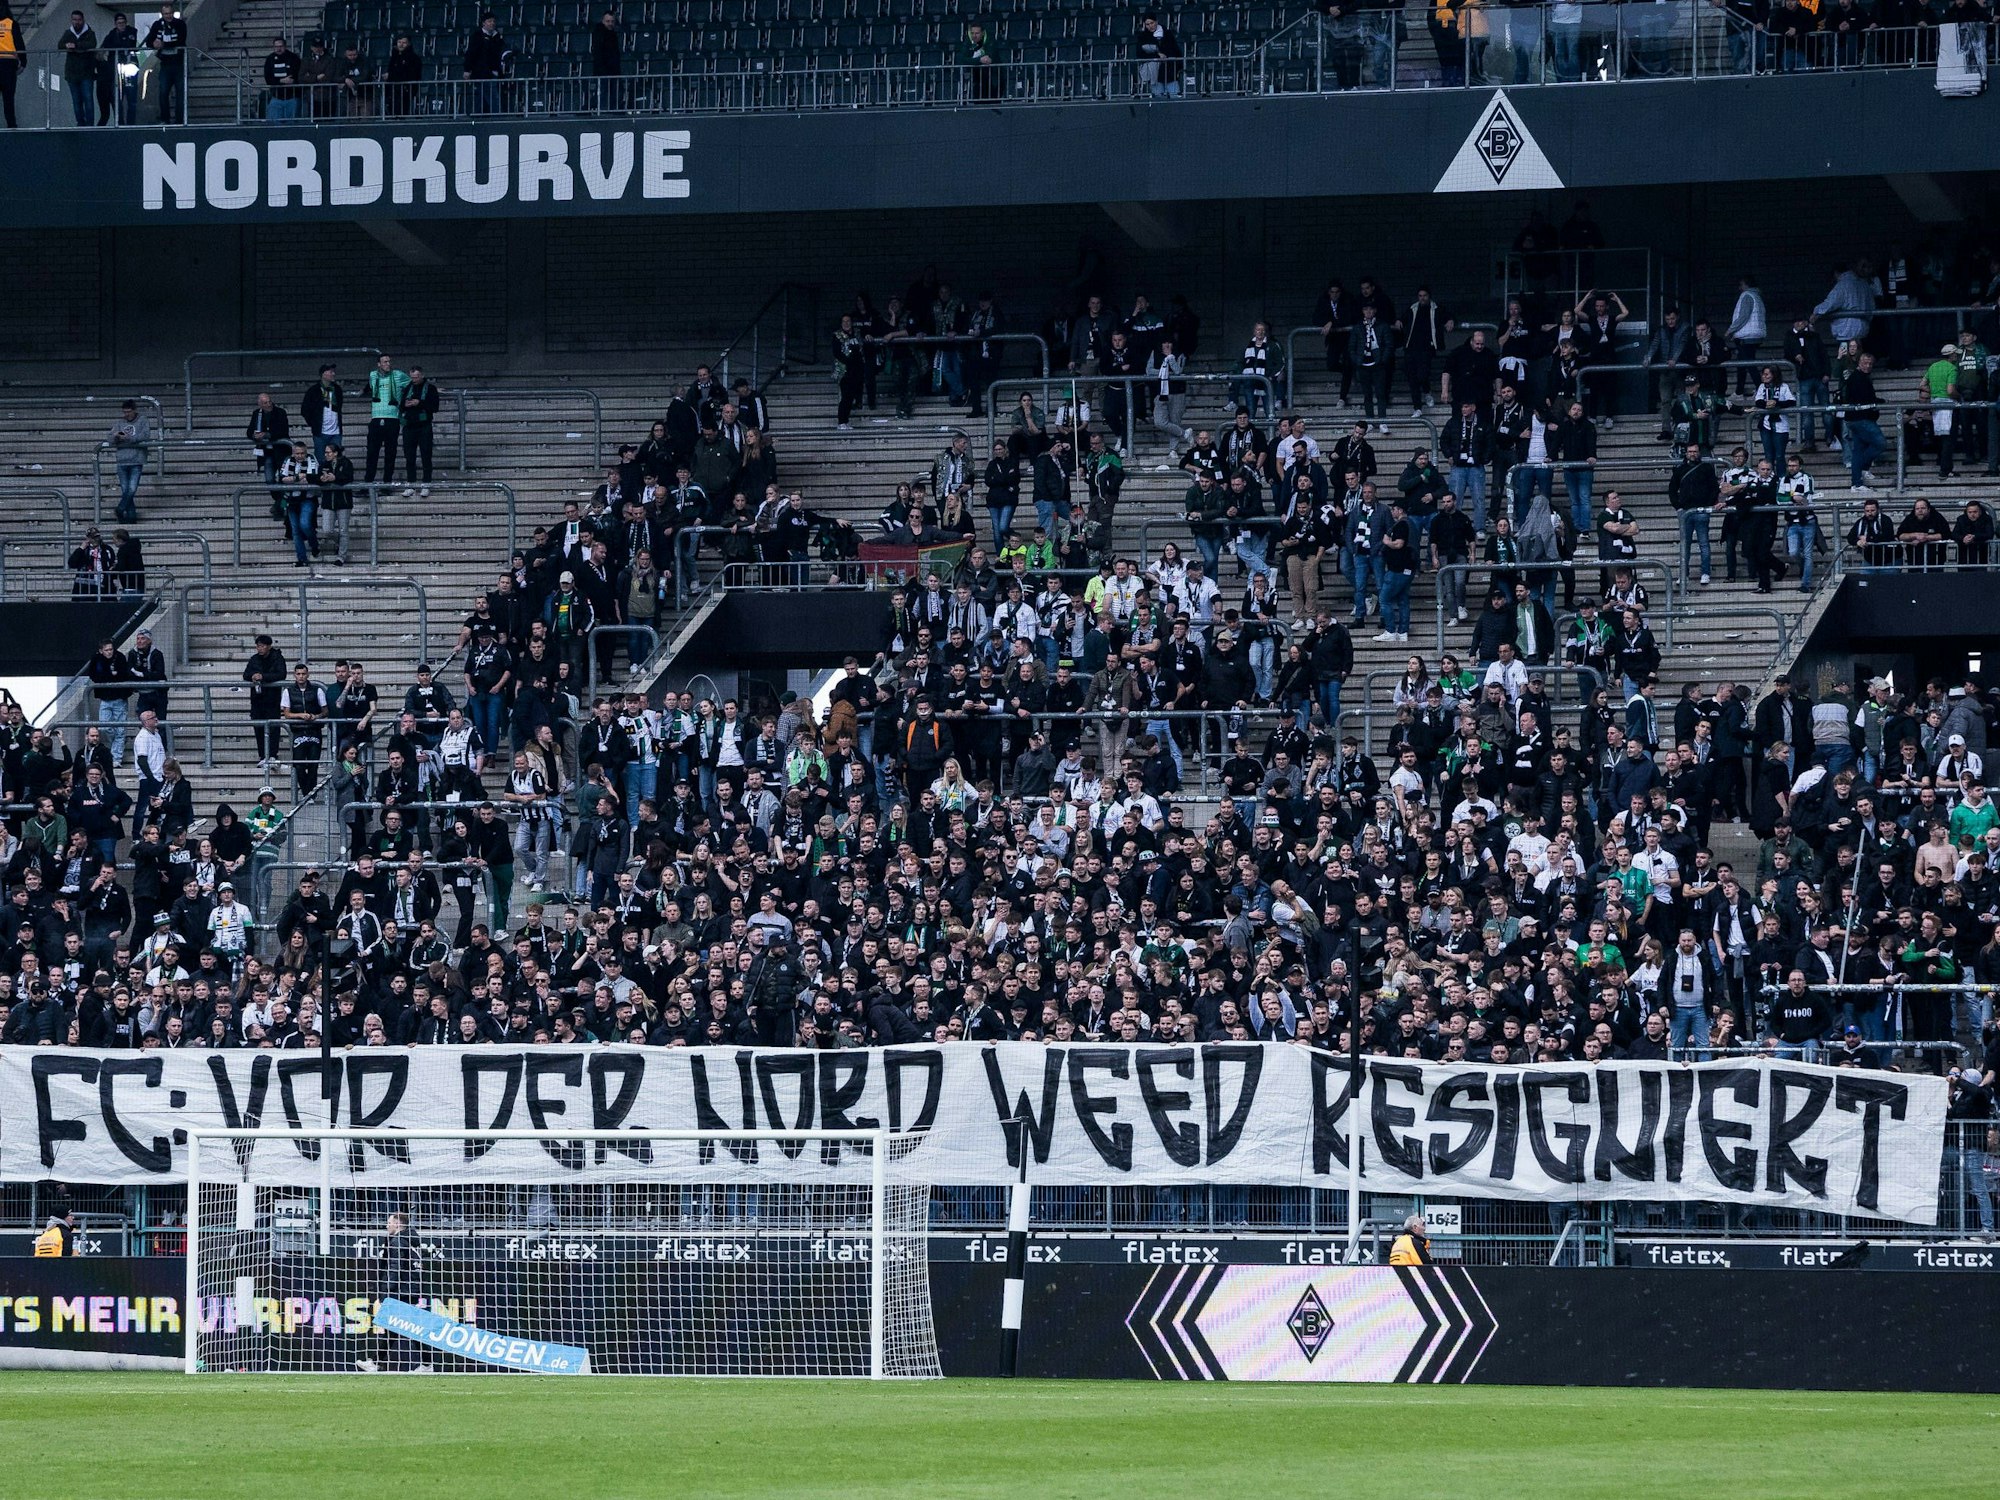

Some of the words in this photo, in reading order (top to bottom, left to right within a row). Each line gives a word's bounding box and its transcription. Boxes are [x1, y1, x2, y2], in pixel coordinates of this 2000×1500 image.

[142, 130, 691, 209] NORDKURVE
[32, 1055, 187, 1173] FC:
[207, 1054, 411, 1172] VOR
[462, 1053, 653, 1169] DER
[691, 1050, 943, 1166] NORD
[982, 1046, 1263, 1171] WEED
[1311, 1055, 1907, 1210] RESIGNIERT
[505, 1238, 598, 1259] flatex
[656, 1239, 750, 1260] flatex
[965, 1240, 1061, 1262] flaex
[1122, 1241, 1219, 1263] flatex
[1648, 1246, 1726, 1264] flatex
[1913, 1249, 1993, 1267] flatex
[52, 1296, 180, 1333] MEHR
[388, 1315, 424, 1337] www.
[429, 1322, 547, 1366] JONGEN
